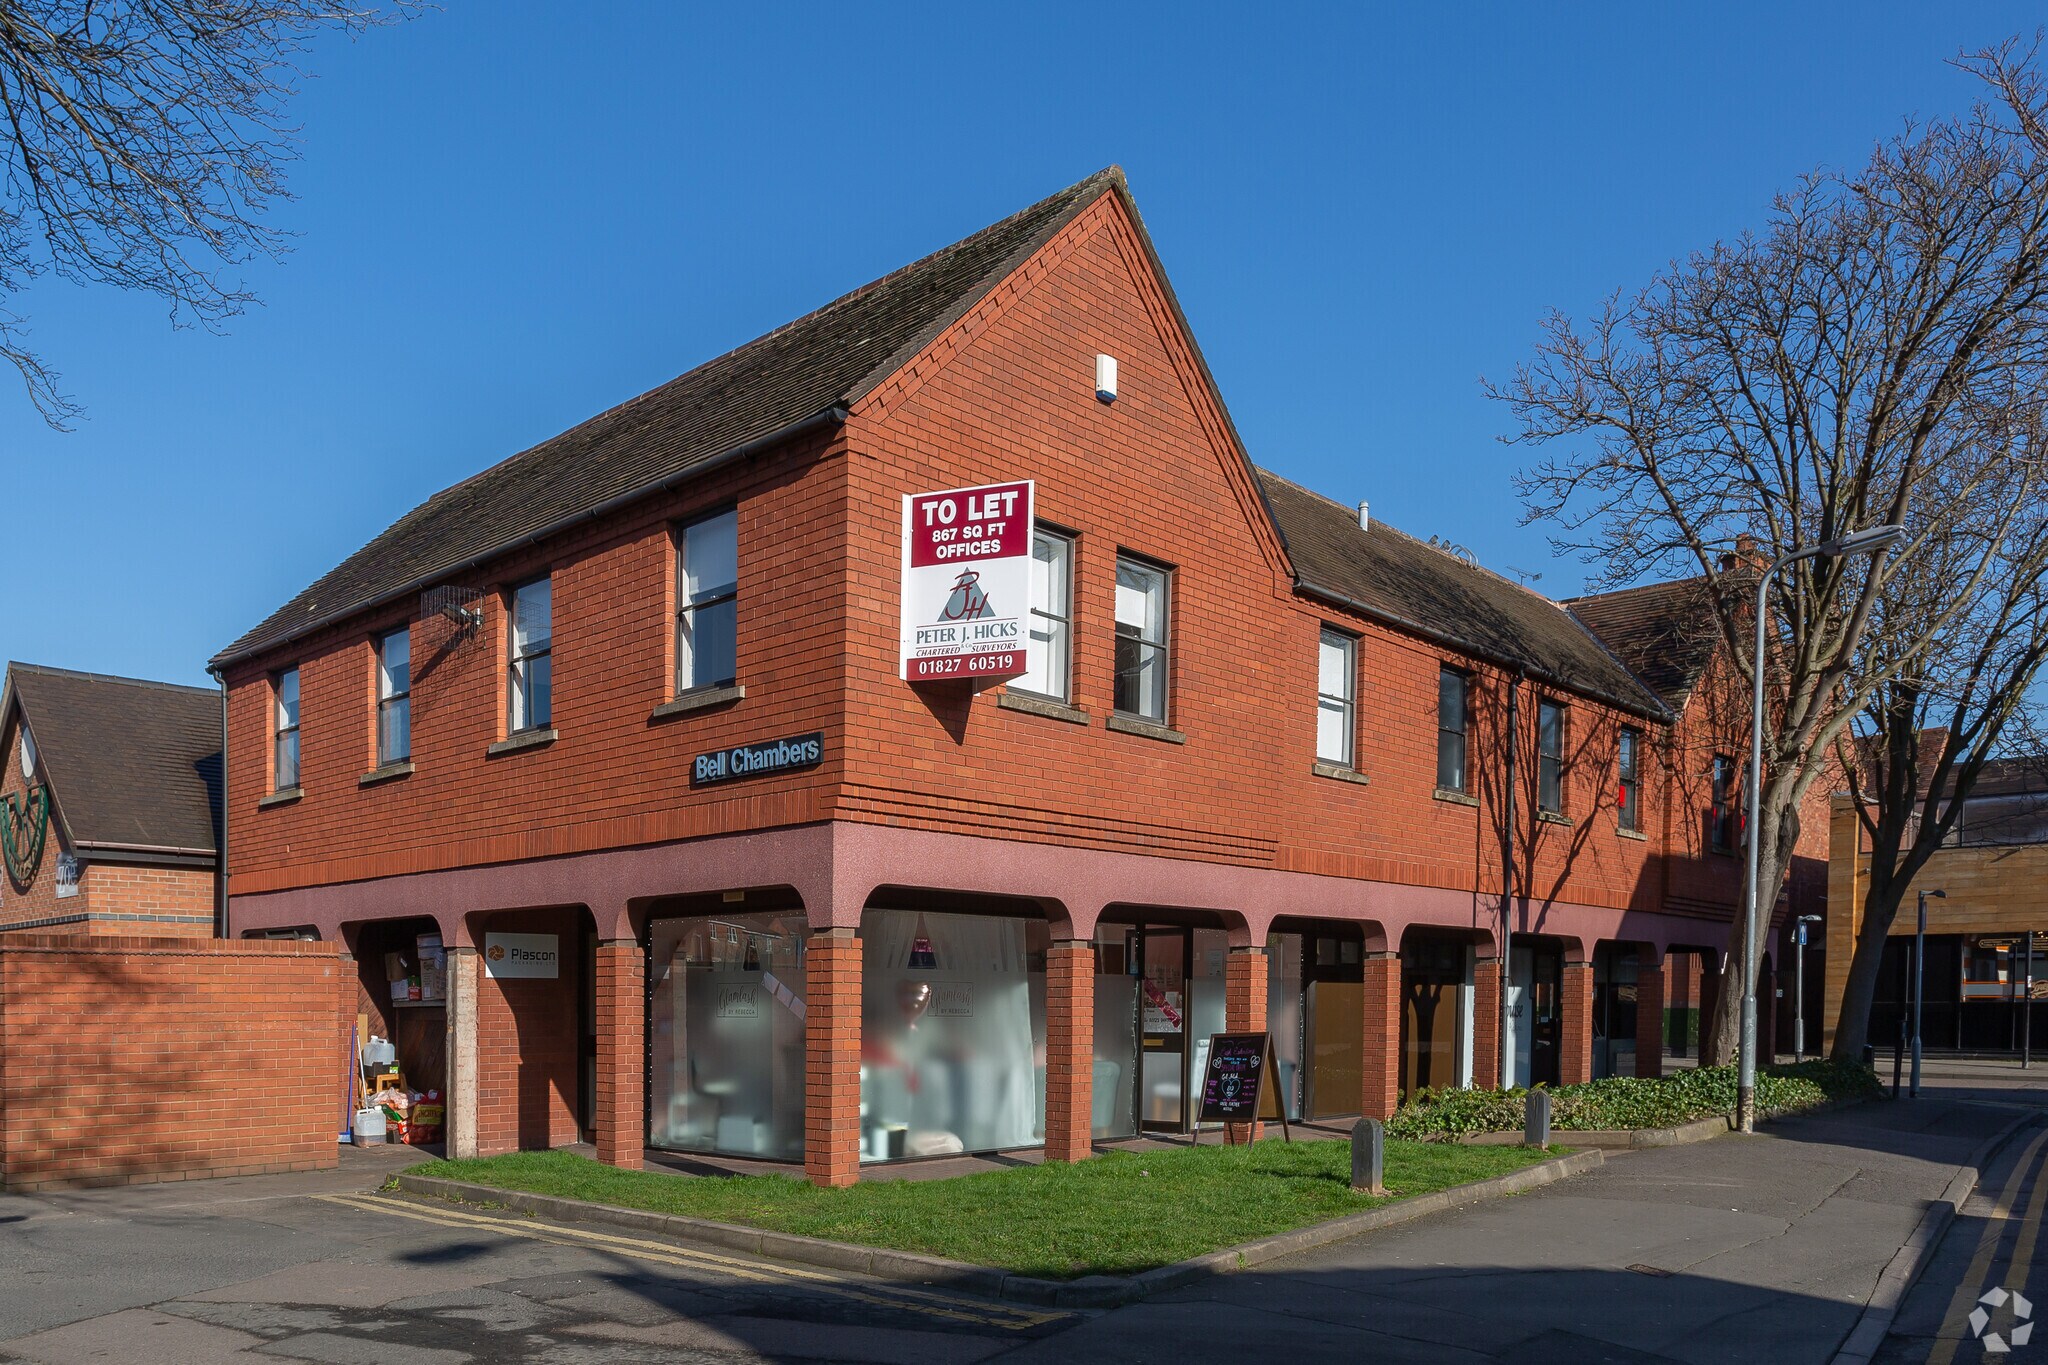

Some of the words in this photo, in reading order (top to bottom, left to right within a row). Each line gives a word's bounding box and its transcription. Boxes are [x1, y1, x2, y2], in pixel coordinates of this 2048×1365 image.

[921, 498, 957, 526] TO
[967, 491, 1019, 521] LET
[932, 527, 958, 543] 867
[962, 525, 983, 540] SQ
[987, 522, 1006, 536] FT
[936, 539, 1001, 559] OFFICES
[916, 627, 956, 645] PETER
[961, 626, 970, 643] J.
[974, 622, 1018, 640] HICKS
[915, 646, 961, 657] CHARTERED
[971, 642, 1017, 654] SURVEYORS
[918, 658, 962, 675] 01827
[968, 654, 1014, 671] 60519
[696, 752, 726, 779] Bell
[730, 740, 819, 774] Chambers
[511, 948, 556, 961] Plascon
